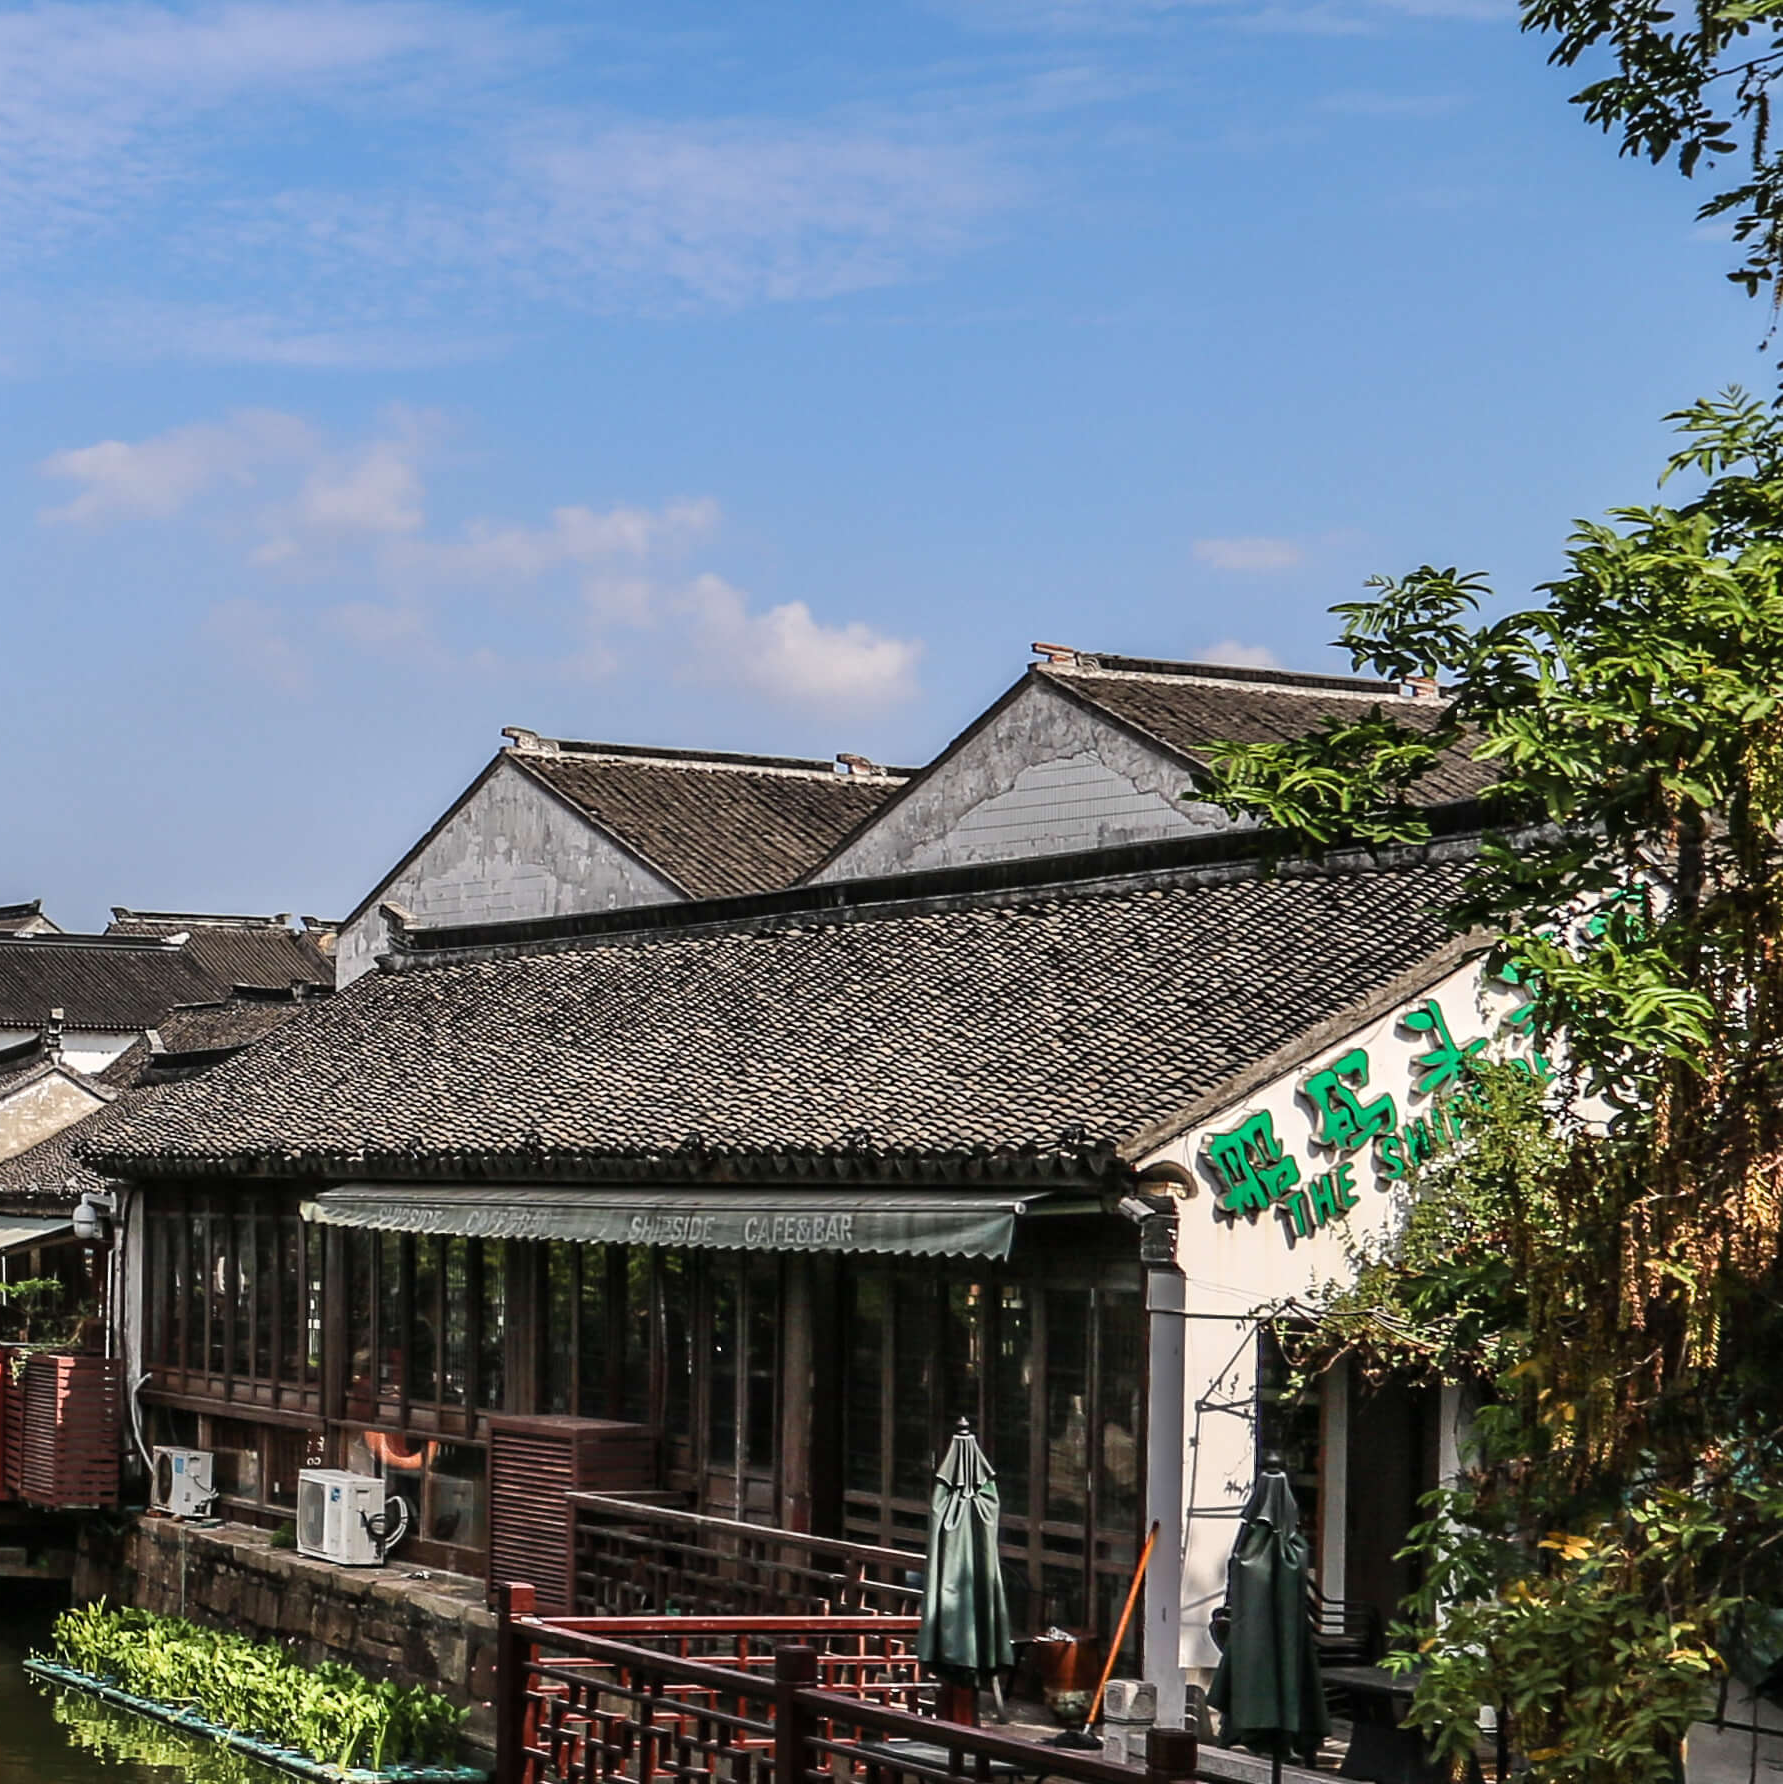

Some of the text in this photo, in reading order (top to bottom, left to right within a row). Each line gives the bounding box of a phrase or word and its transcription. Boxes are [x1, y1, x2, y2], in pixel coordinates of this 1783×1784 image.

[1286, 1162, 1361, 1238] THE
[628, 1215, 853, 1244] SHIPSIDE CAFE&BAR
